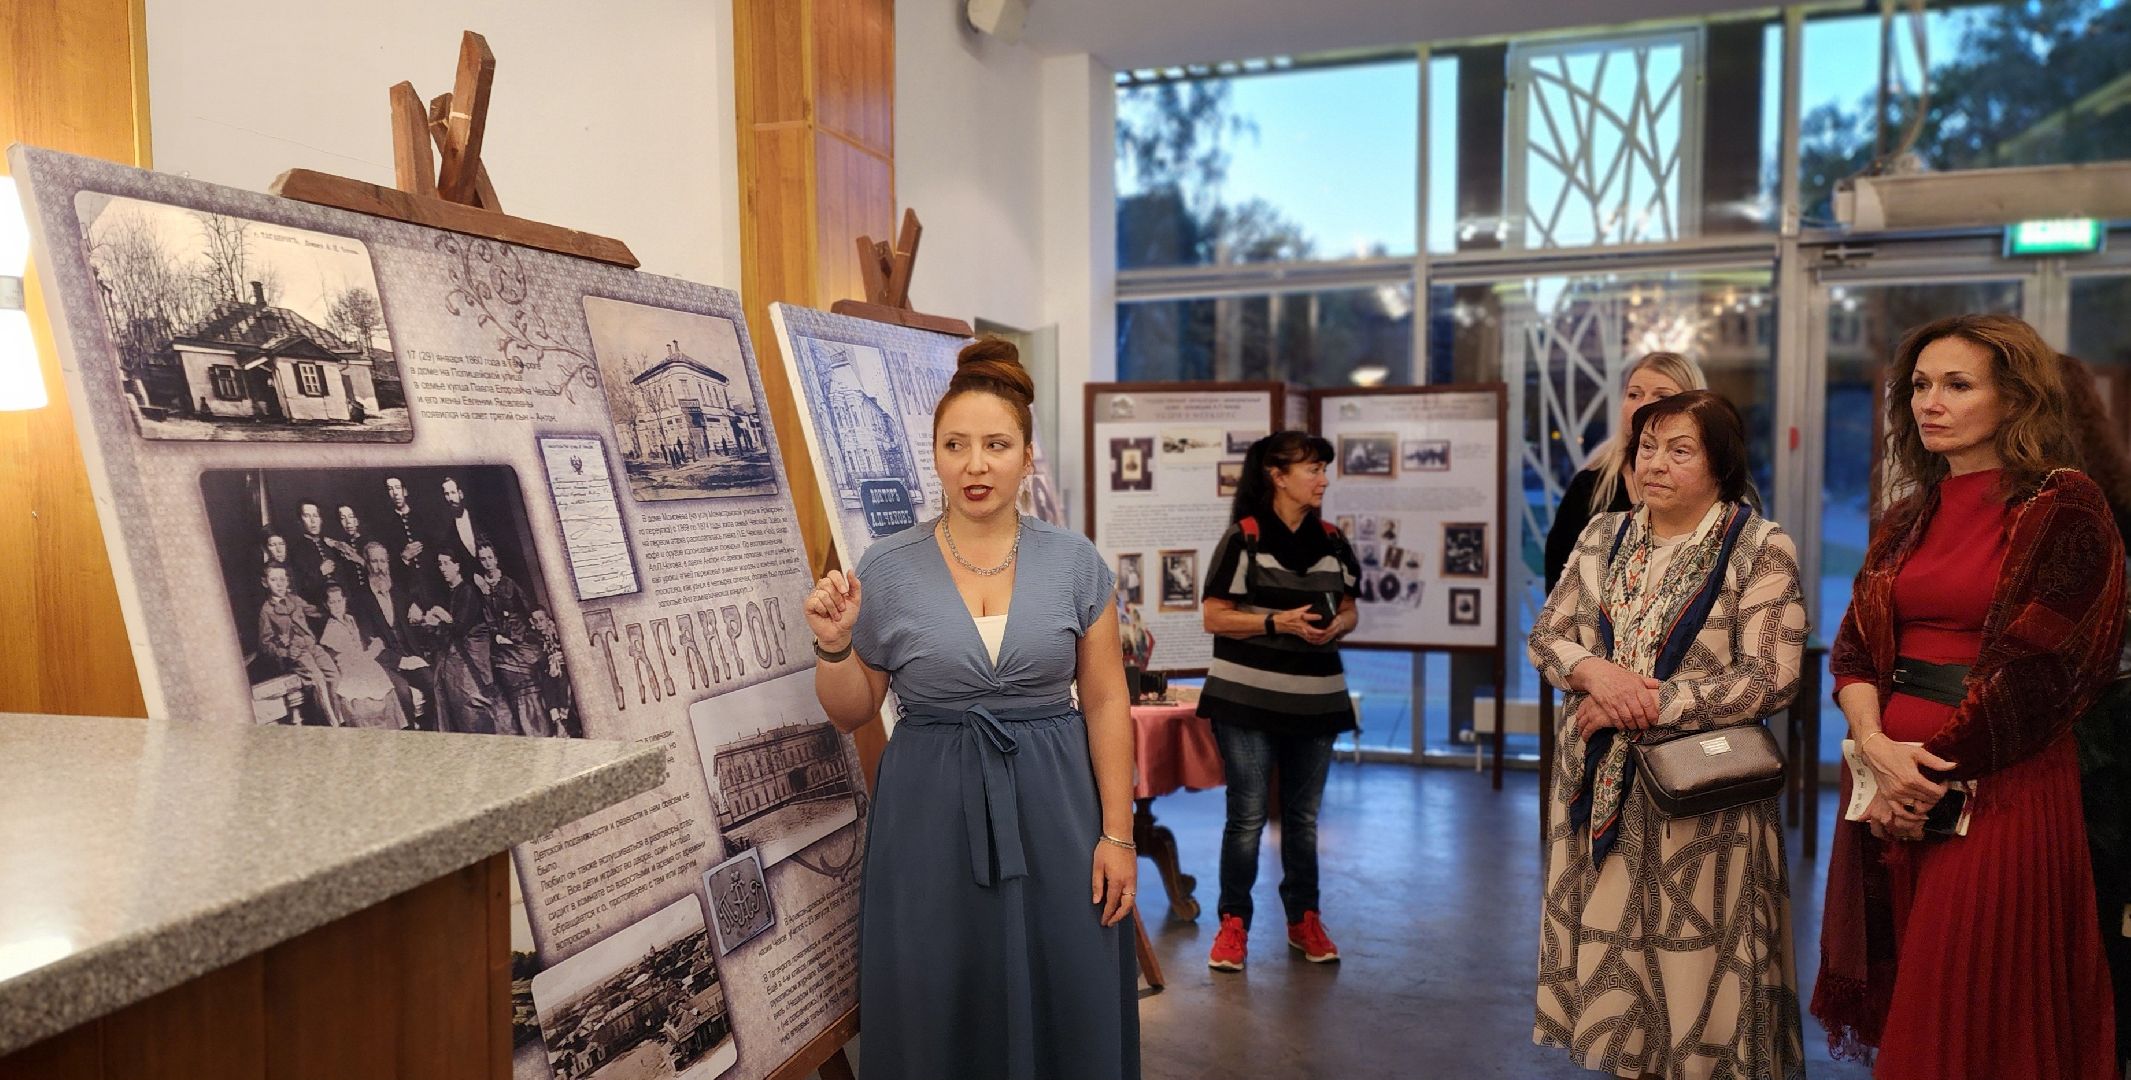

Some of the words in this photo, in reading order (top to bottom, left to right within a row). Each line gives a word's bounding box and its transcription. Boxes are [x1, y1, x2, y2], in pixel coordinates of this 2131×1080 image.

[435, 354, 464, 365] января
[416, 367, 439, 376] доме
[450, 367, 500, 380] Полицейской
[420, 381, 446, 390] семье
[447, 383, 470, 394] купца
[470, 382, 494, 393] Павла
[439, 396, 461, 404] жены
[461, 395, 492, 406] Евгении
[420, 410, 459, 419] появился
[488, 410, 513, 422] третий
[581, 596, 787, 712] ТАГАНРОГ
[533, 841, 563, 862] Детской
[564, 825, 608, 848] подвижности
[661, 795, 681, 808] совсем
[540, 872, 566, 891] Любил
[578, 860, 597, 874] также
[567, 881, 581, 895] Все
[582, 876, 598, 889] дети
[576, 888, 605, 907] комнате
[615, 867, 650, 889] взрослыми
